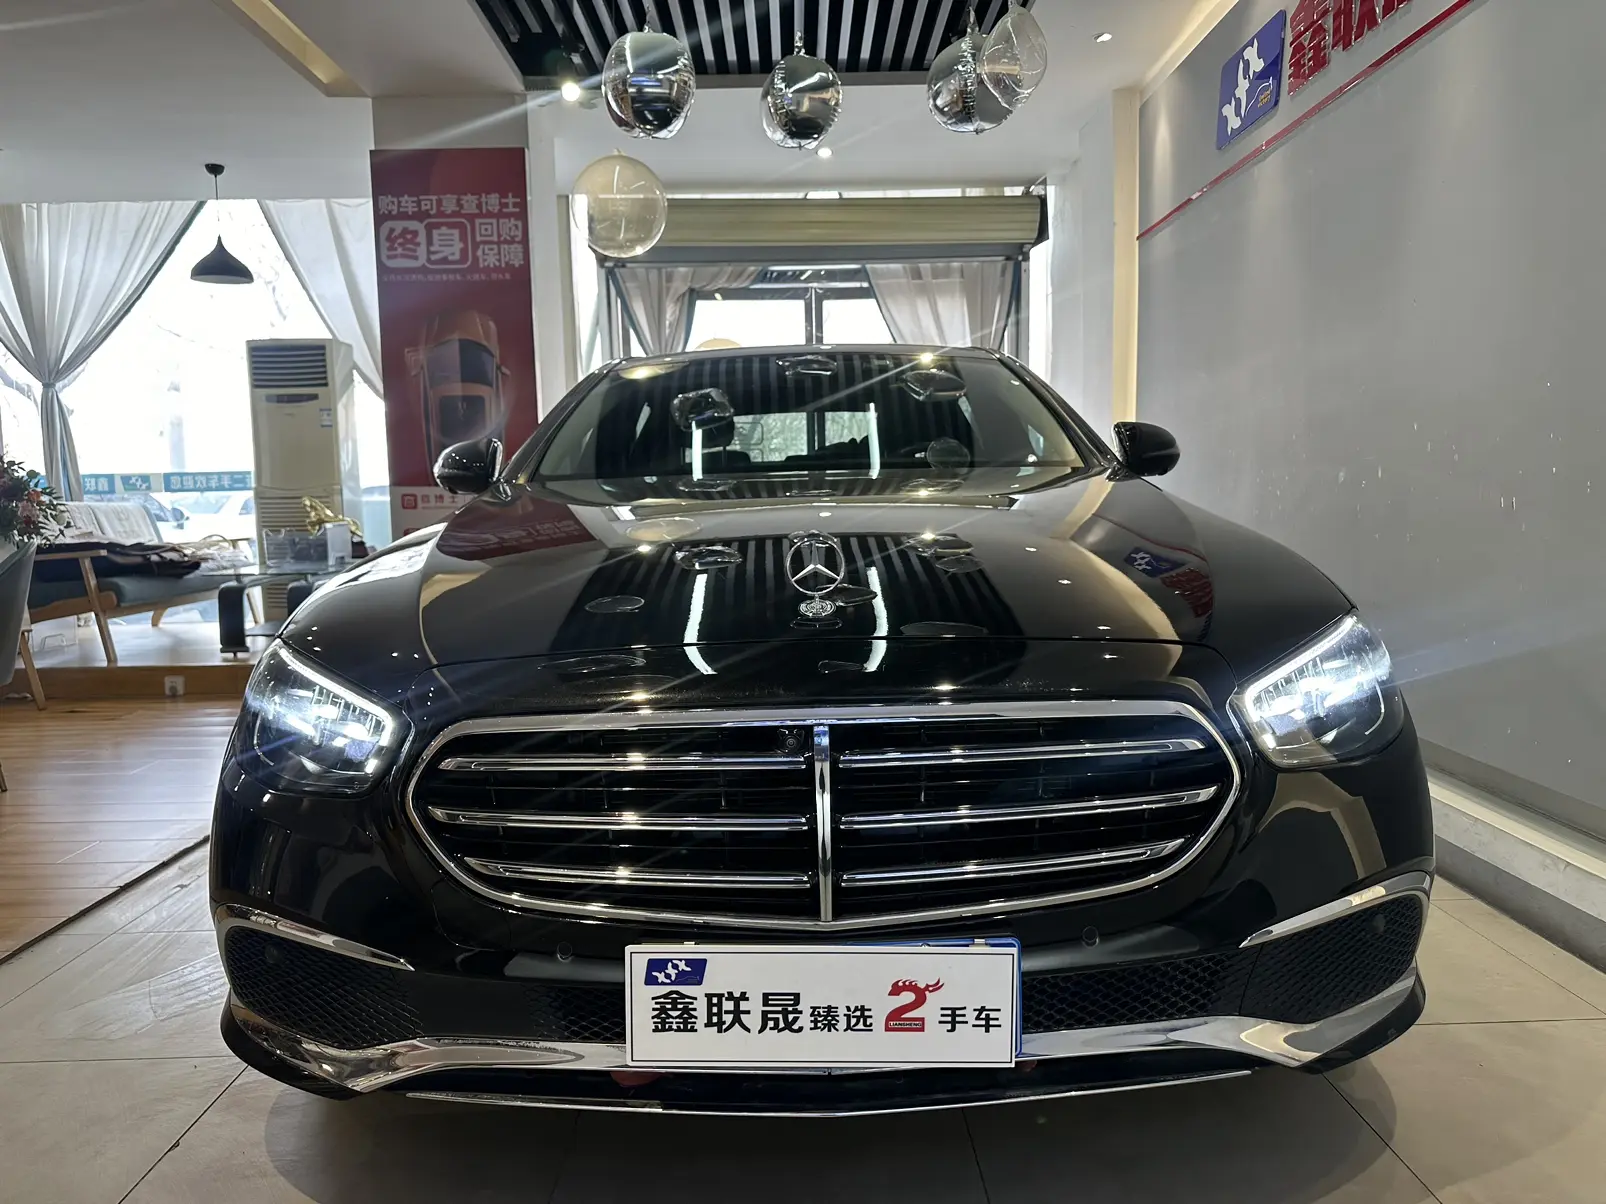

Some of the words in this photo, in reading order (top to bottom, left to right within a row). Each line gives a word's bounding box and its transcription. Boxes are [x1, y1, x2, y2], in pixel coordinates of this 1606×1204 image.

[378, 193, 521, 215] 购车可享查博士
[475, 218, 522, 242] 回购
[384, 226, 464, 261] 终身
[476, 244, 524, 268] 保障
